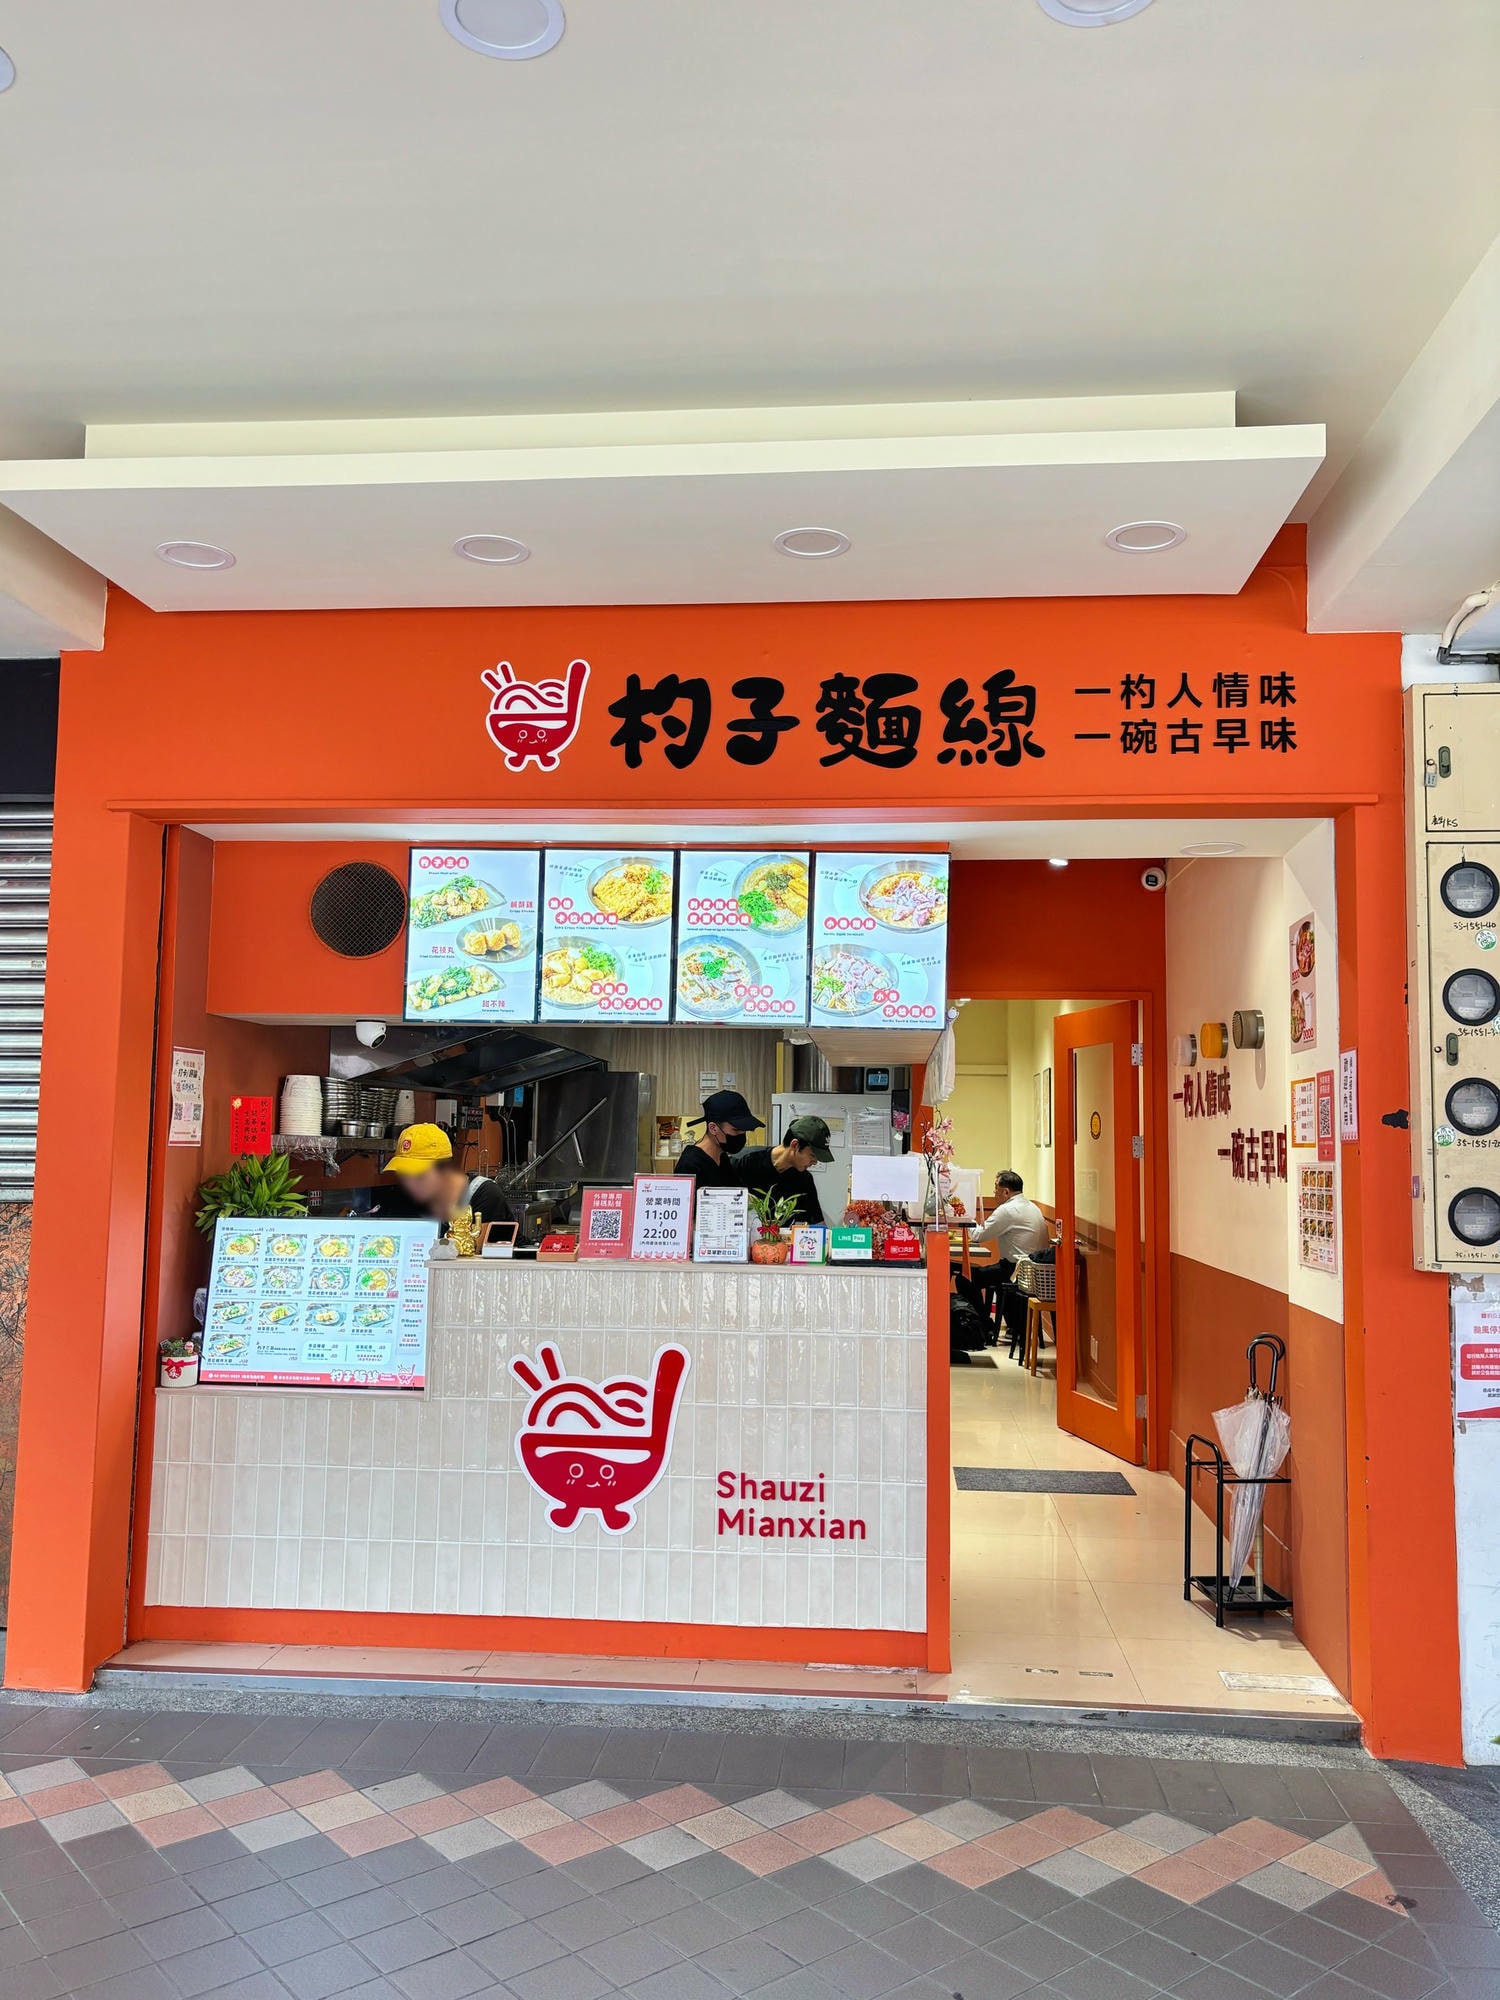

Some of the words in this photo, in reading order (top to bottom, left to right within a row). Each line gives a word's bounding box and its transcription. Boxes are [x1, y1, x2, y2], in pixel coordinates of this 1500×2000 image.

[1074, 671, 1298, 708] 一杓人情味
[607, 668, 1046, 769] 杓子麵線
[1074, 717, 1298, 755] 一碗古早味
[1172, 1066, 1231, 1119] 一杓人情味
[645, 1197, 681, 1206] 營業時間
[645, 1210, 678, 1220] 11:00
[643, 1228, 677, 1239] 22:00
[716, 1470, 825, 1503] Shauzi
[717, 1508, 866, 1540] Mianxian
